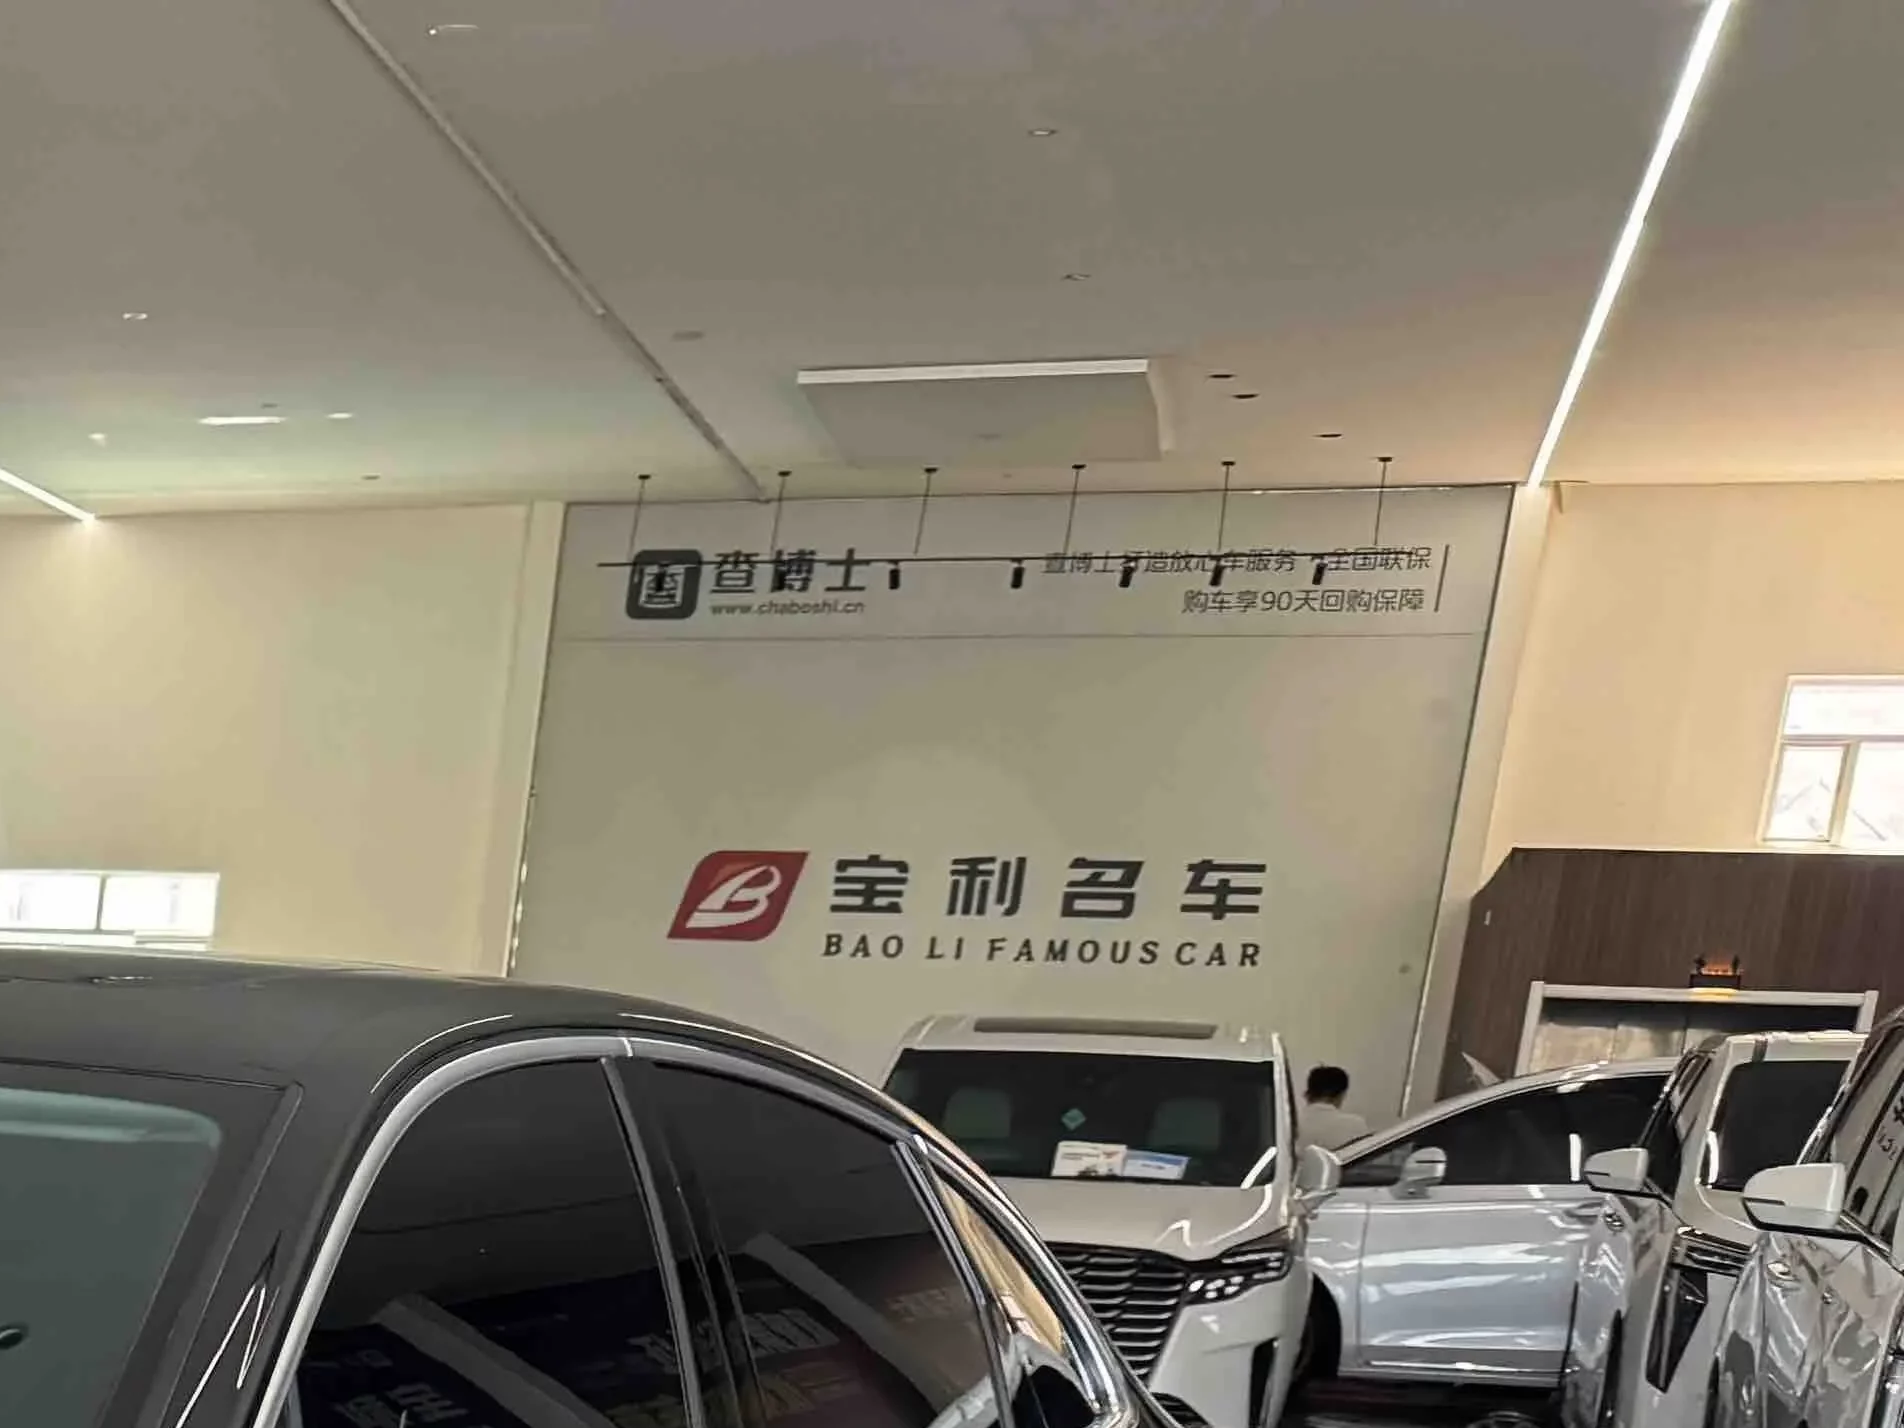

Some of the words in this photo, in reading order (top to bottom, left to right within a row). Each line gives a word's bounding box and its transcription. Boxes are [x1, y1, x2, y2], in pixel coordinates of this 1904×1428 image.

[1182, 589, 1425, 614] 购车享90天回购保障
[829, 854, 1267, 921] 宝利名车
[822, 934, 905, 959] BAO
[925, 936, 965, 961] LI
[986, 937, 1161, 965] FAMOUS
[1174, 942, 1262, 968] CAR
